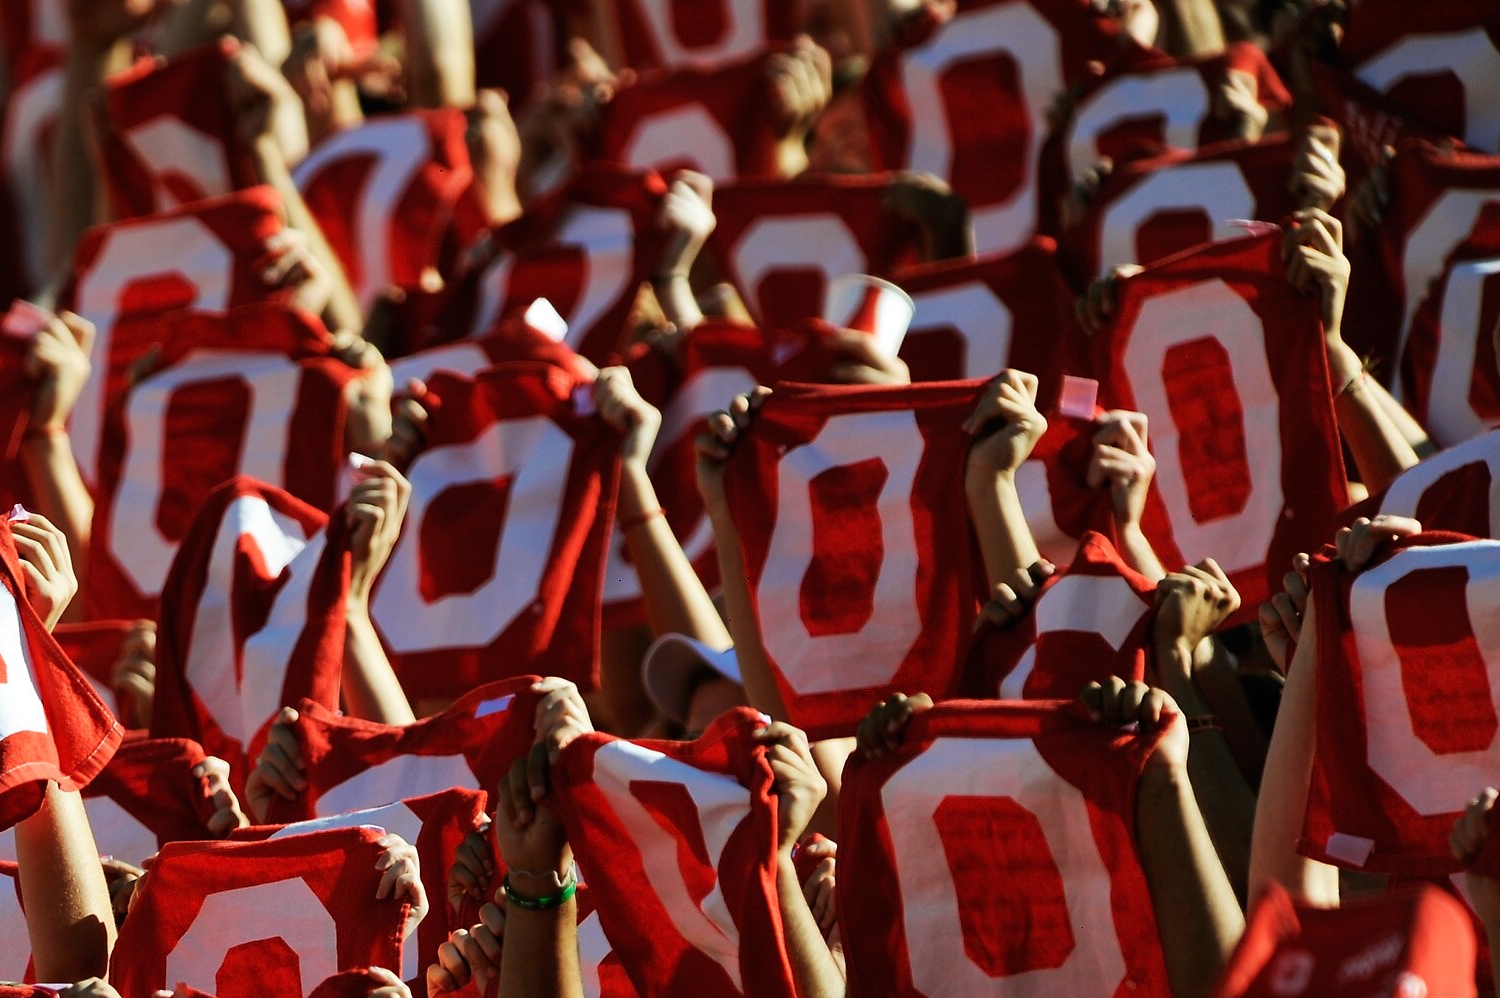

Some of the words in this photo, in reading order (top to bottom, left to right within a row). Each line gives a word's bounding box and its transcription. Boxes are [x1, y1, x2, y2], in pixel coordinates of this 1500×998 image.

[904, 6, 1062, 254] O
[109, 353, 298, 598] O
[371, 418, 573, 653] O
[1126, 279, 1283, 569] O
[759, 412, 924, 694] O
